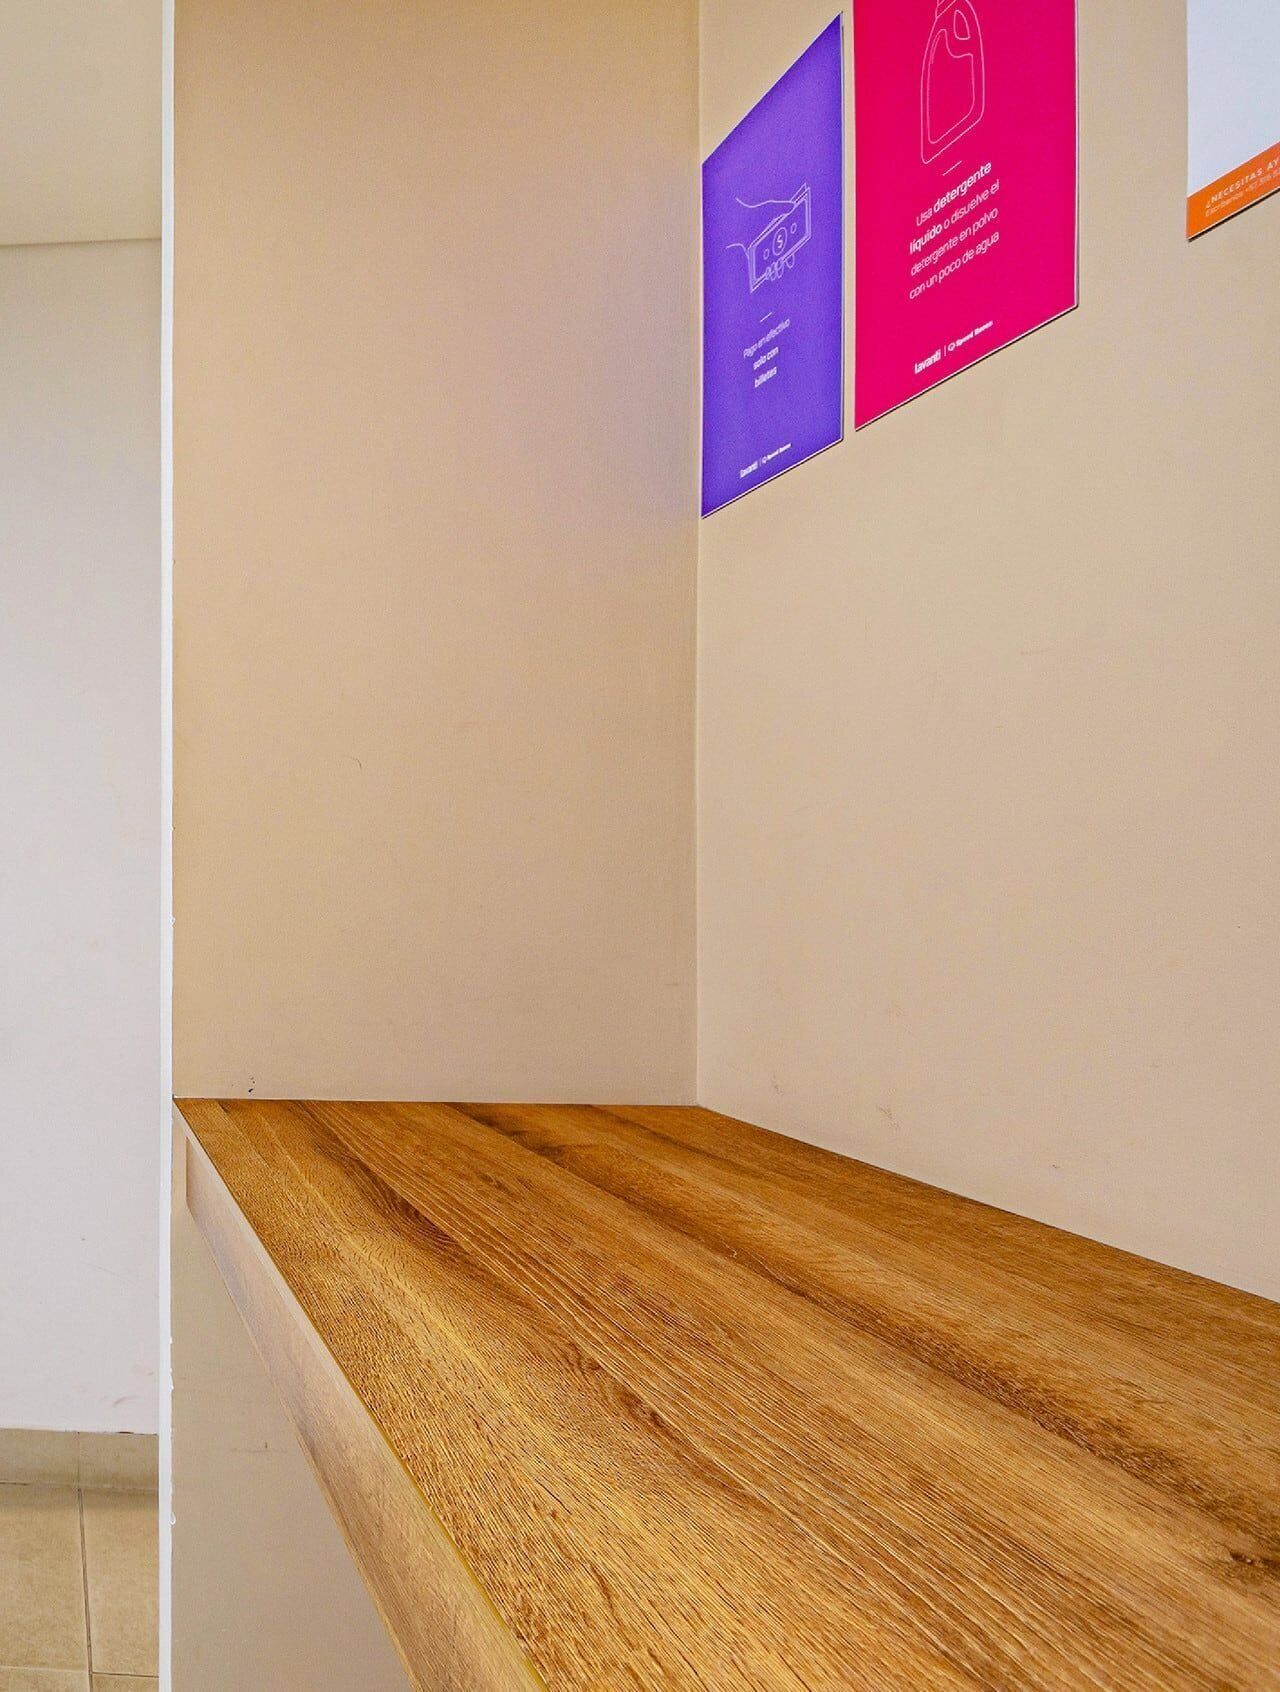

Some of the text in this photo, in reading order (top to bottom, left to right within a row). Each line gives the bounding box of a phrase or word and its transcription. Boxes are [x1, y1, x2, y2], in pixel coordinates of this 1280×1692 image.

[909, 179, 1000, 254] líquido o disuelve el
[916, 161, 992, 227] Usa detergente
[909, 231, 1000, 300] con un poco de agua
[910, 207, 999, 276] detergente en polvo
